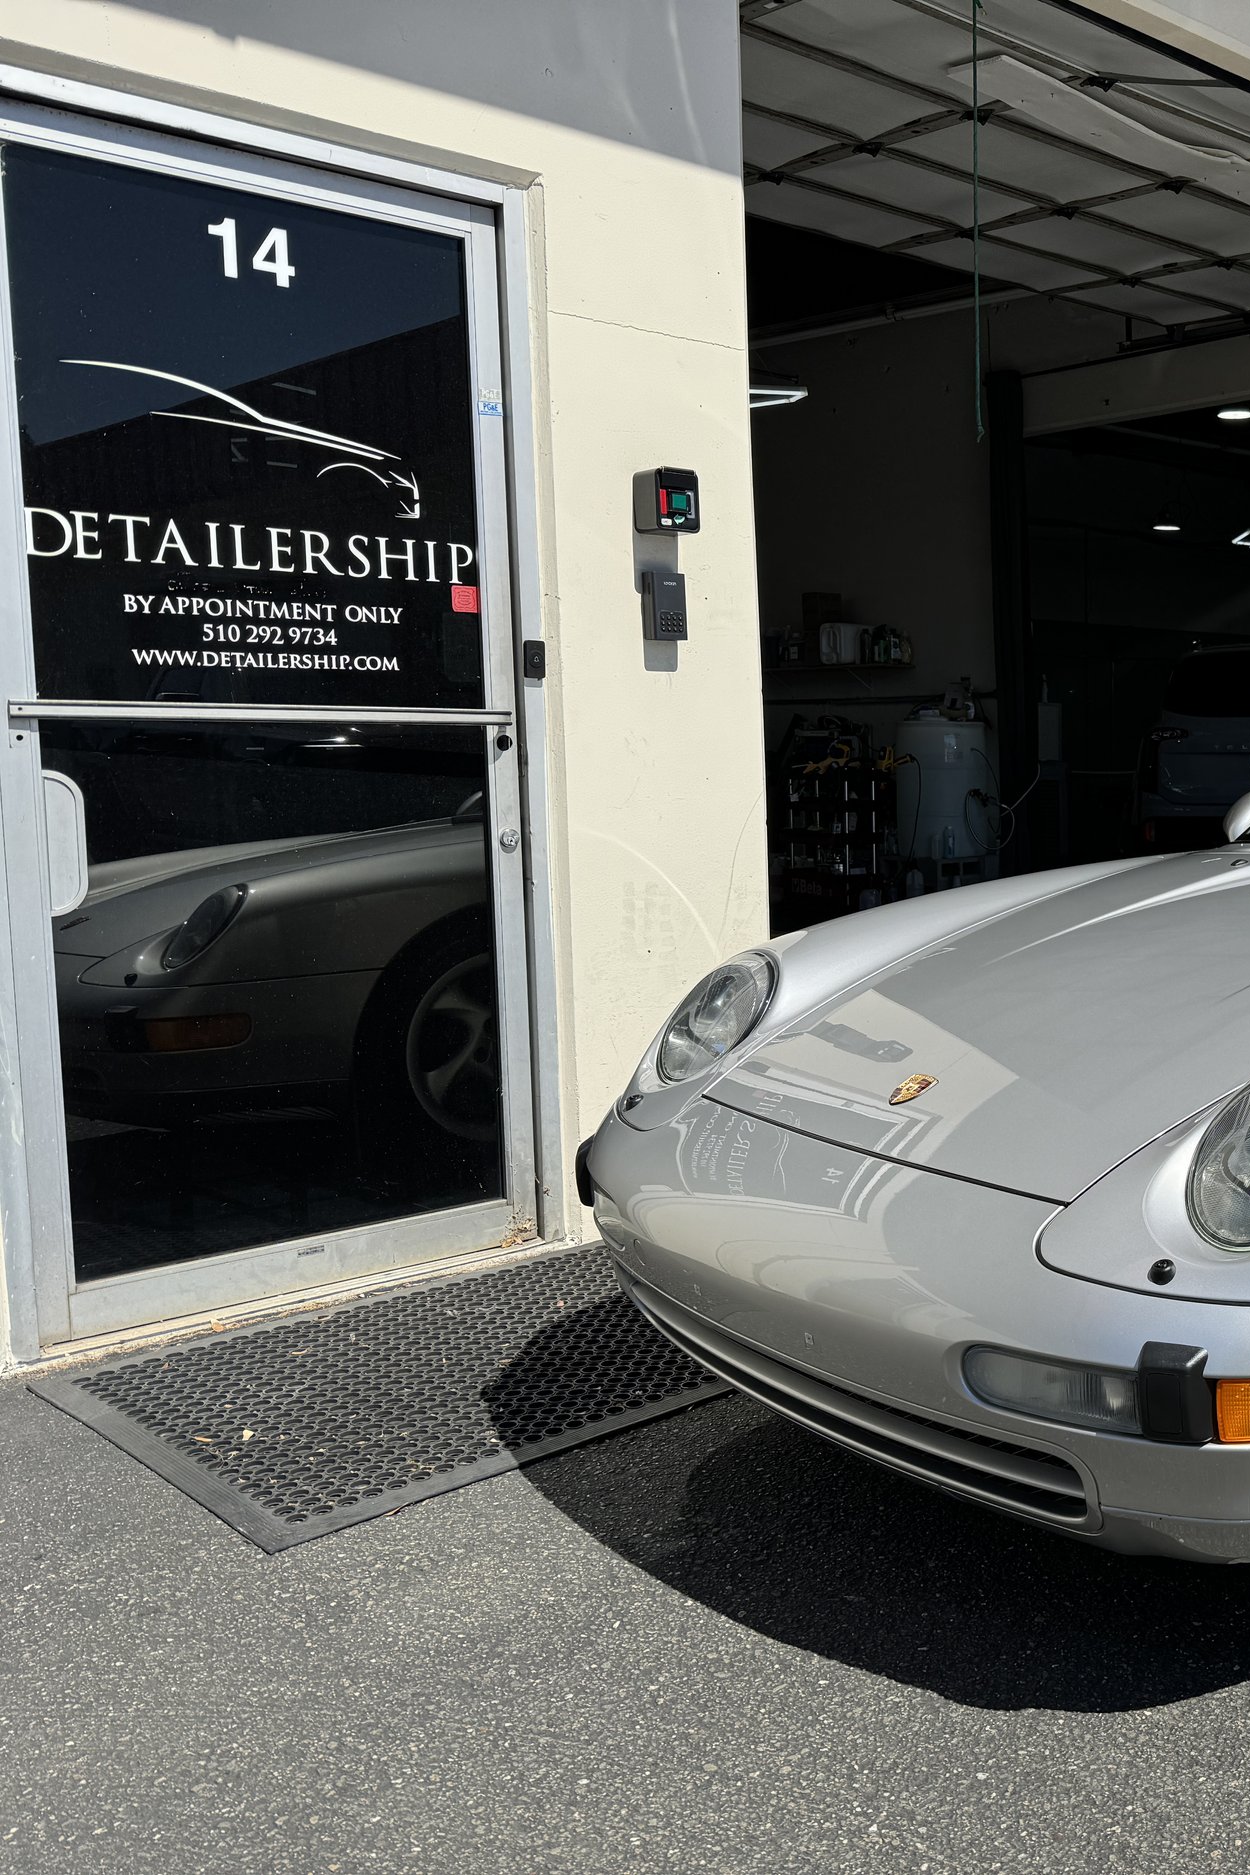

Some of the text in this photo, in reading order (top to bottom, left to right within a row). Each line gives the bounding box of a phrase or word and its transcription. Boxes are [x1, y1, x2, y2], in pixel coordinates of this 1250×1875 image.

[207, 216, 296, 288] 14
[24, 506, 474, 585] DETAILERSHIP
[123, 594, 404, 624] BY APPOINTMENT ONLY
[202, 623, 338, 646] 510 292 9734
[131, 648, 400, 671] WWW.DETAILERSHIP.COM
